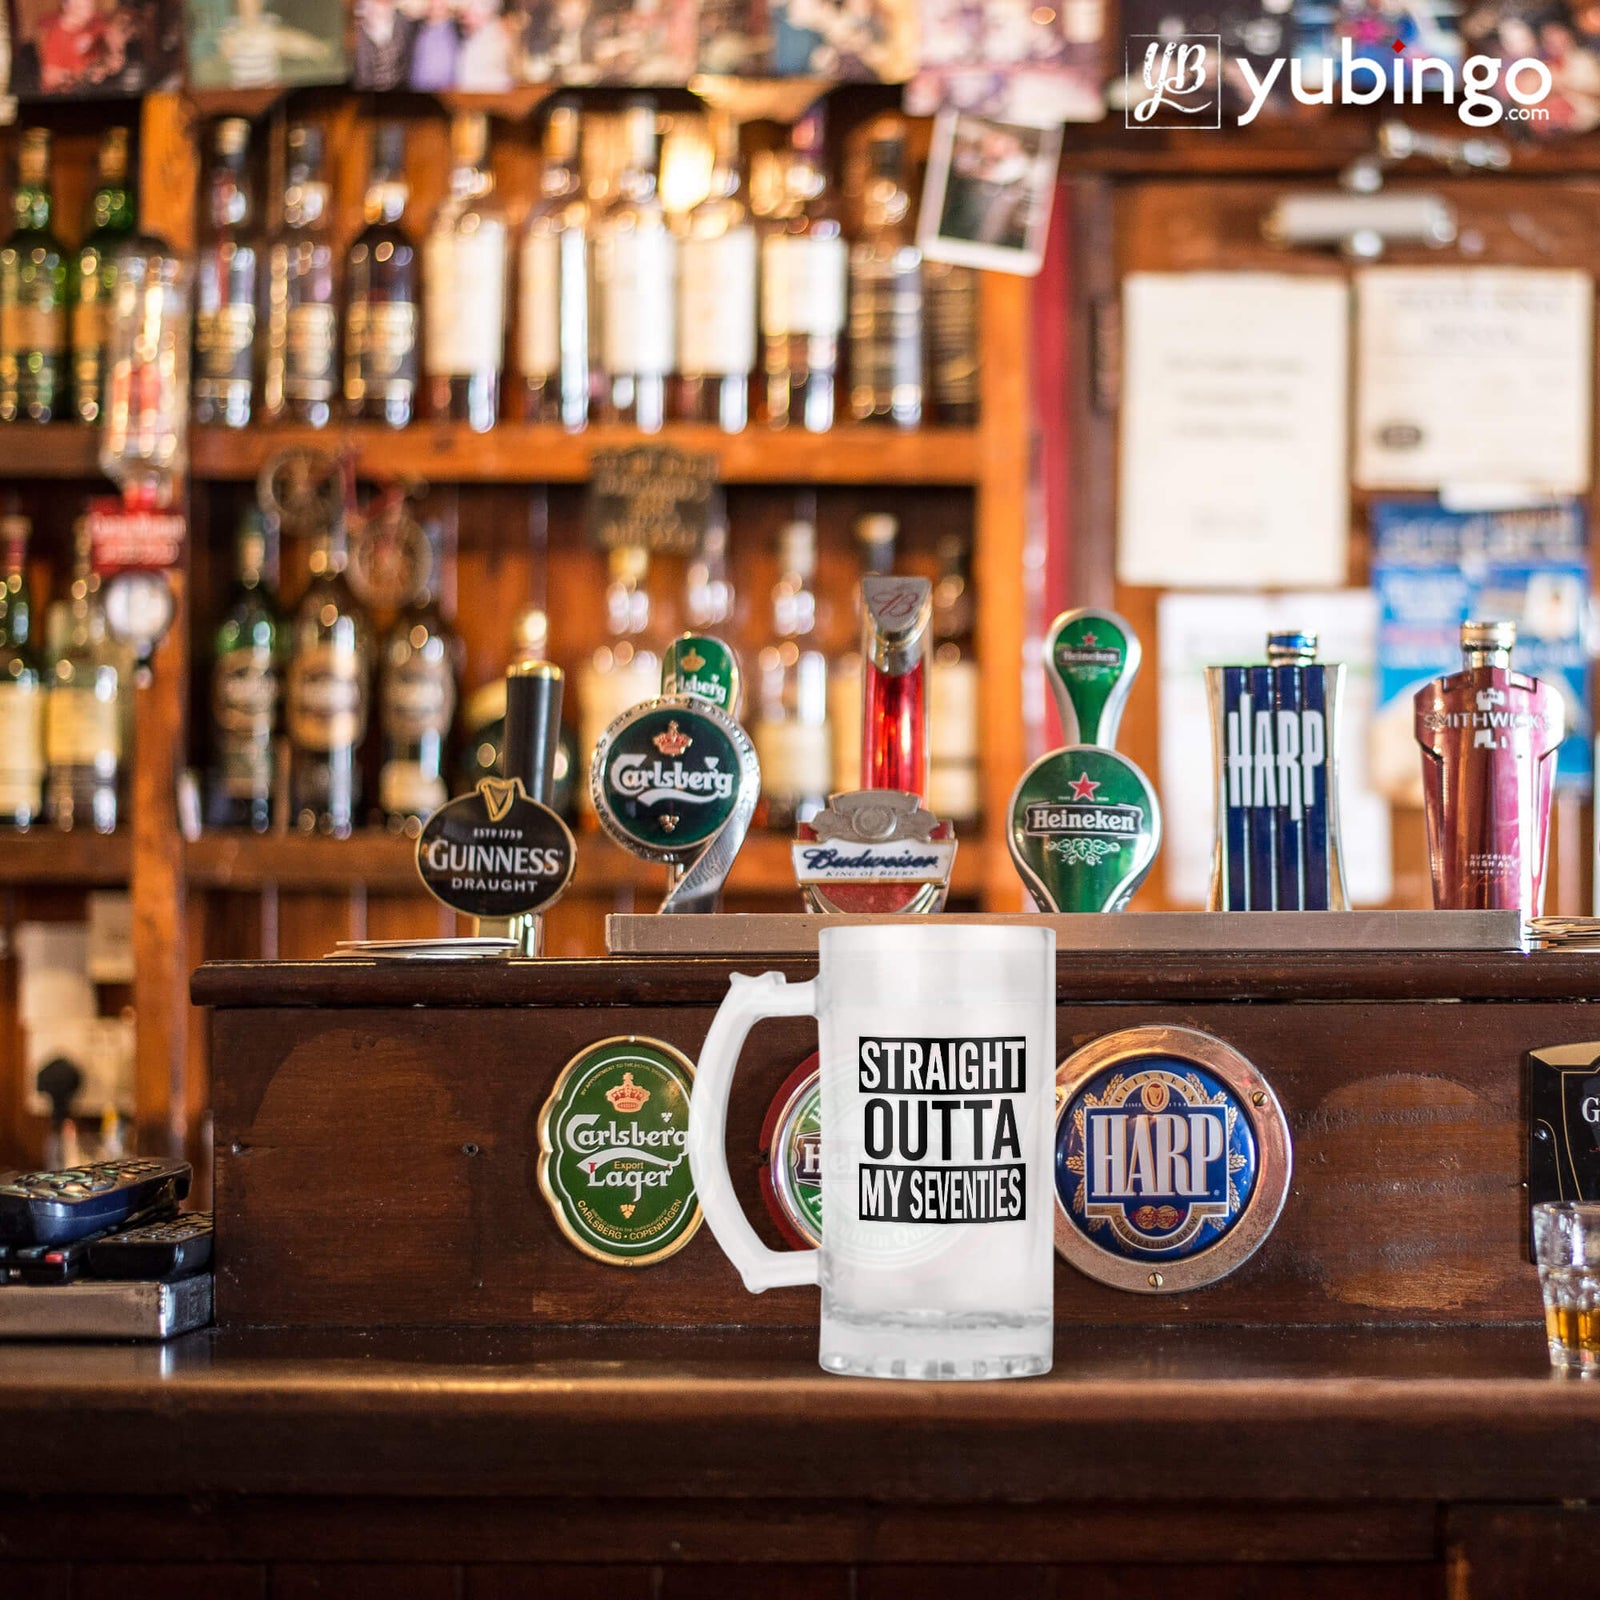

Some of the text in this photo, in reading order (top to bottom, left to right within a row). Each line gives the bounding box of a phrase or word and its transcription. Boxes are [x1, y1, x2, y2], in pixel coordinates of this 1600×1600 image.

[610, 753, 735, 799] Carlsberg
[1227, 692, 1325, 821] HARP
[499, 828, 524, 840] 1759
[1033, 809, 1135, 831] Heineken
[428, 839, 560, 876] GUINNESS
[803, 848, 939, 870] Budweiser
[452, 877, 538, 893] DRAUGHT
[860, 1040, 1025, 1091] STRAIGHT
[1114, 1073, 1196, 1104] GUINNESS
[1582, 1096, 1600, 1123] G
[564, 1113, 689, 1155] Carlsberg
[864, 1097, 1022, 1161] OUTTA
[613, 1160, 645, 1173] Export
[1090, 1113, 1225, 1198] HARP
[586, 1161, 673, 1203] Lager
[861, 1168, 904, 1218] MY
[909, 1168, 1021, 1220] SEVENTIES
[577, 1198, 683, 1241] CARLSBERG COPENHAGEN
